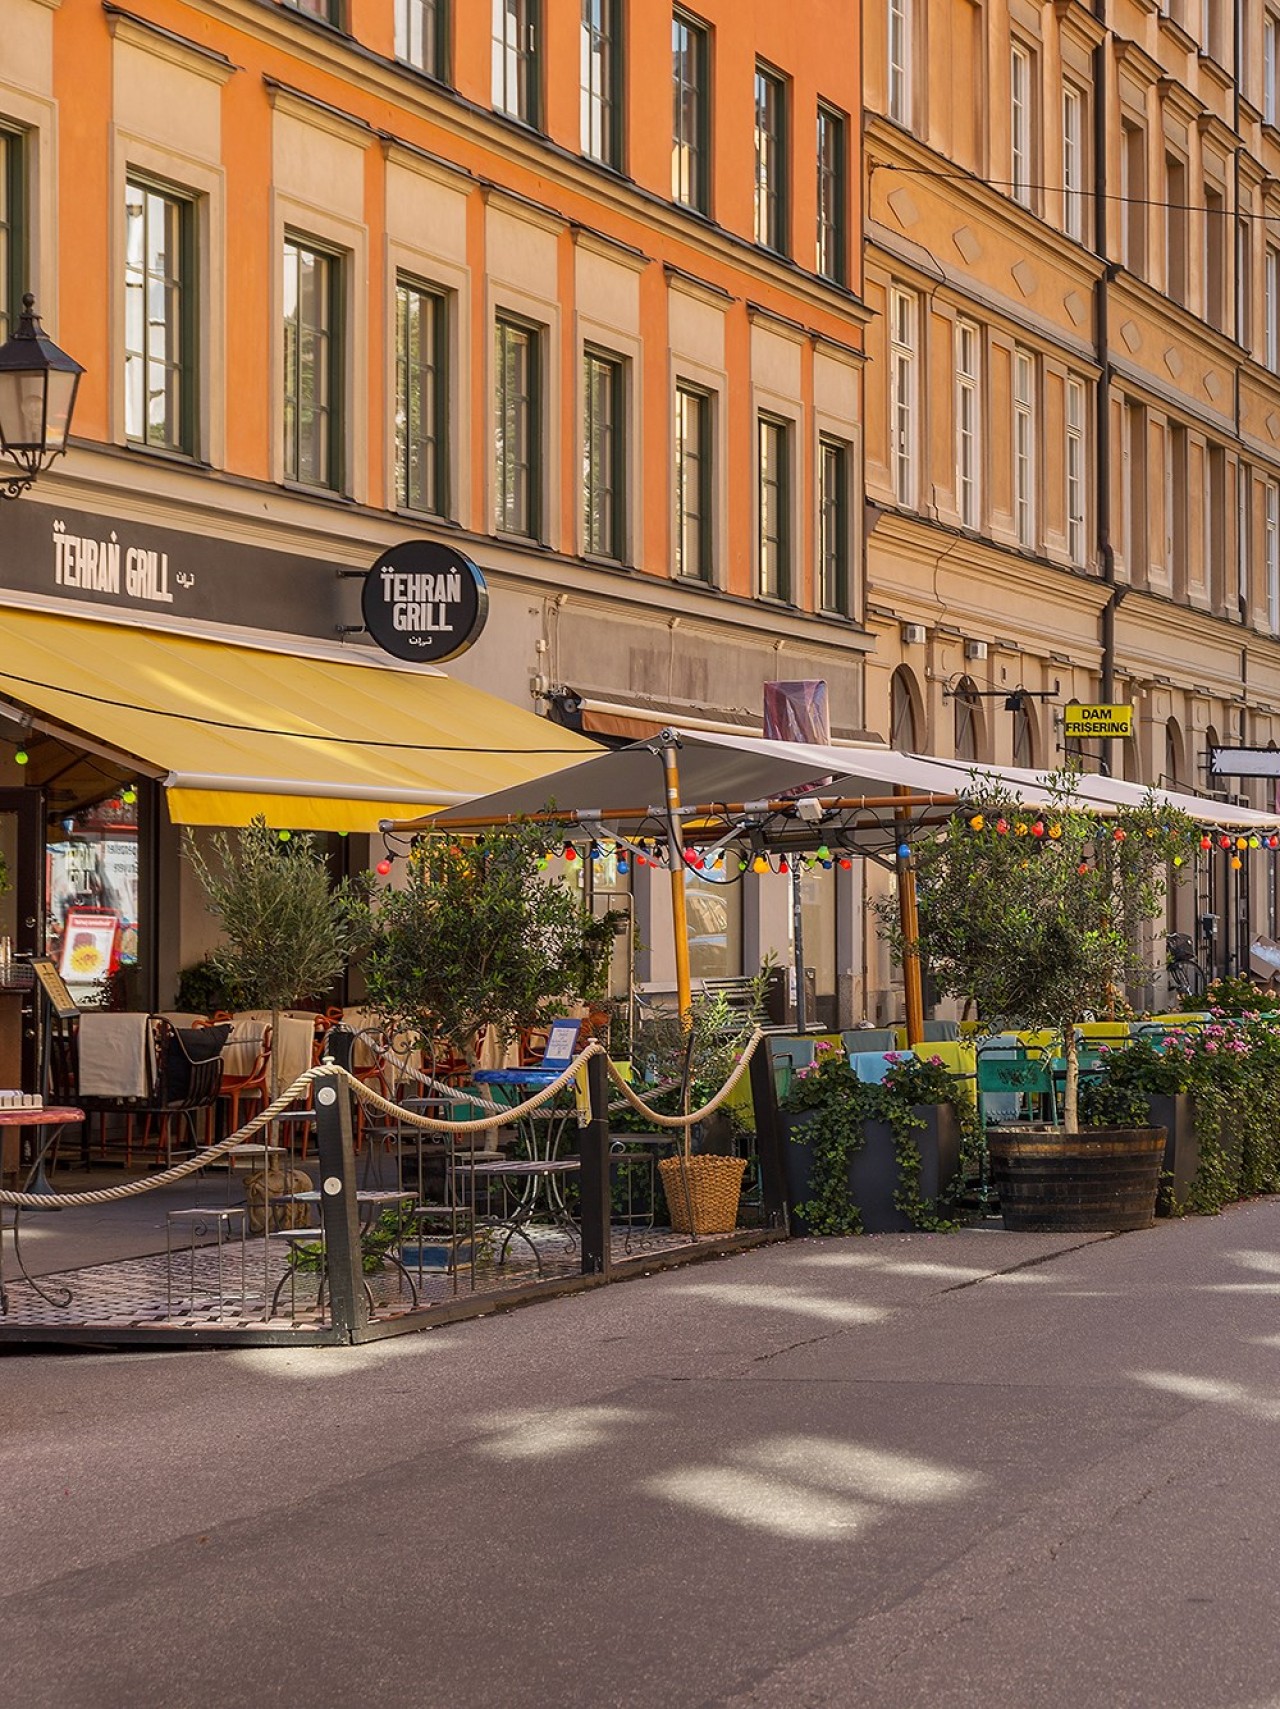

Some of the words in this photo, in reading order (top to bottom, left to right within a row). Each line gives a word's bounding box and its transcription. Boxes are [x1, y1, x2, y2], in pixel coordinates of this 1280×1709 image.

[125, 546, 174, 603] GRILL
[392, 602, 454, 632] GRILL
[1082, 709, 1112, 719] DAM
[1065, 722, 1129, 733] FRISERING
